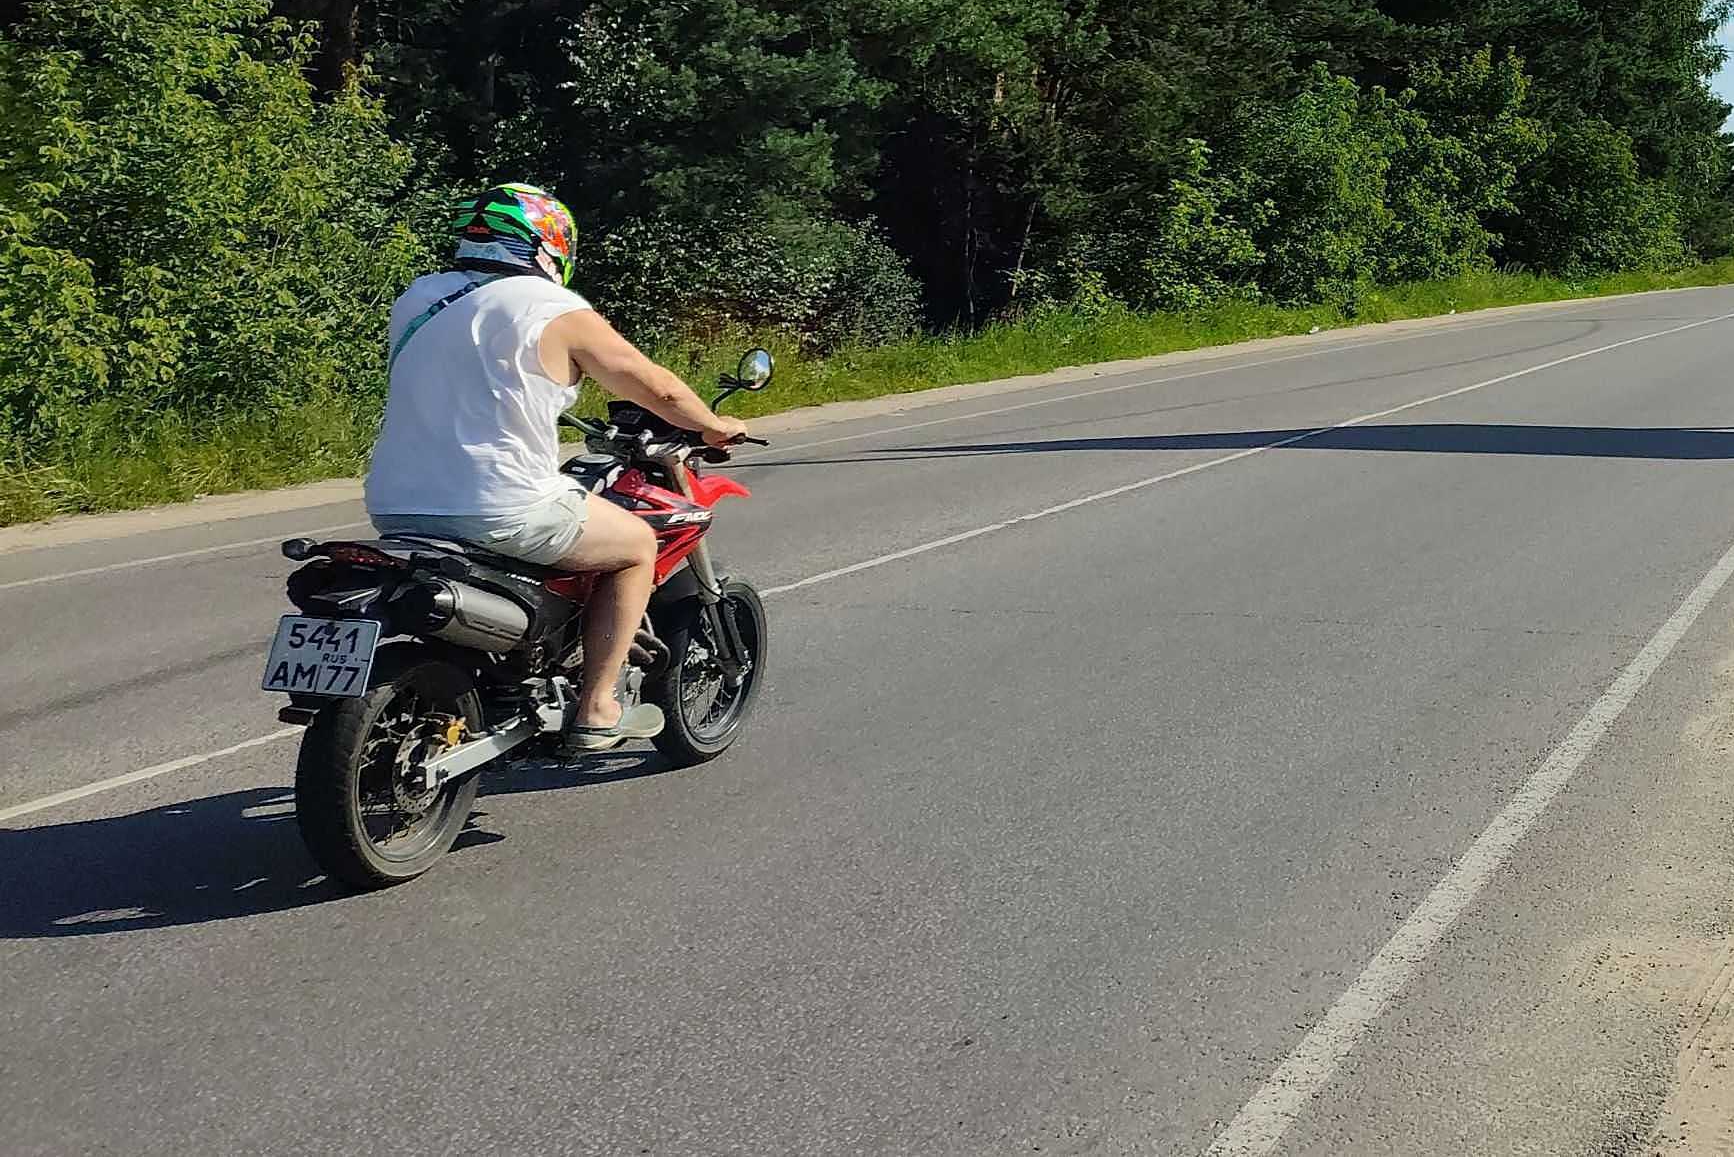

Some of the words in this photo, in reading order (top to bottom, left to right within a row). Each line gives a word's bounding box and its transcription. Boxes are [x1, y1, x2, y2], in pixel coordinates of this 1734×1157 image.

[288, 623, 360, 654] 5441
[321, 652, 348, 664] RUS
[269, 661, 318, 690] АМ
[324, 665, 360, 692] 77
